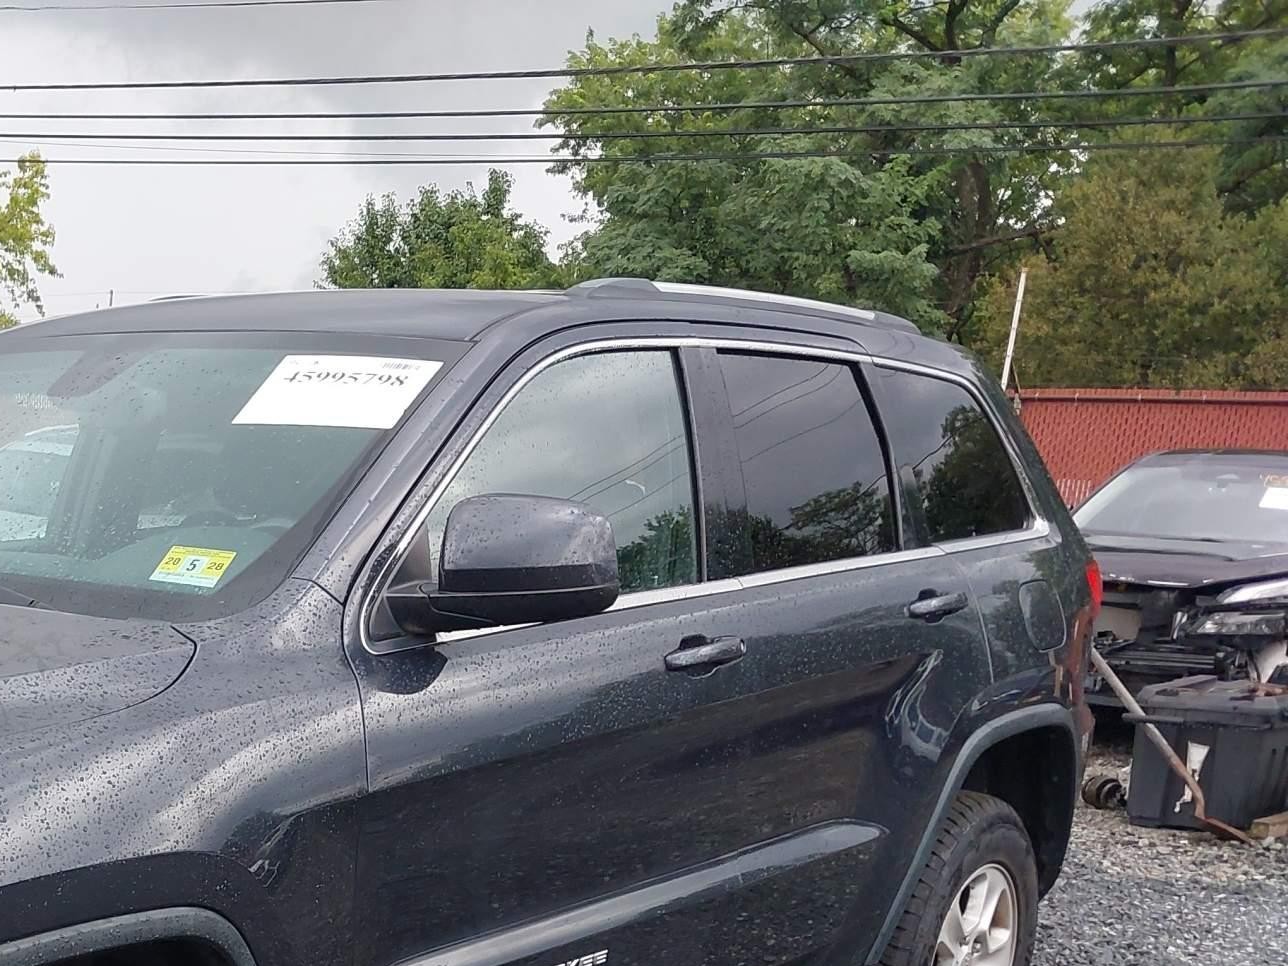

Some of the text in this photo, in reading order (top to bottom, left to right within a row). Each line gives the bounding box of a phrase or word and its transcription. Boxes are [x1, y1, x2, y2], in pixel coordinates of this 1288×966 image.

[283, 370, 409, 387] 45995798
[165, 556, 181, 566] 20
[186, 559, 200, 571] 5
